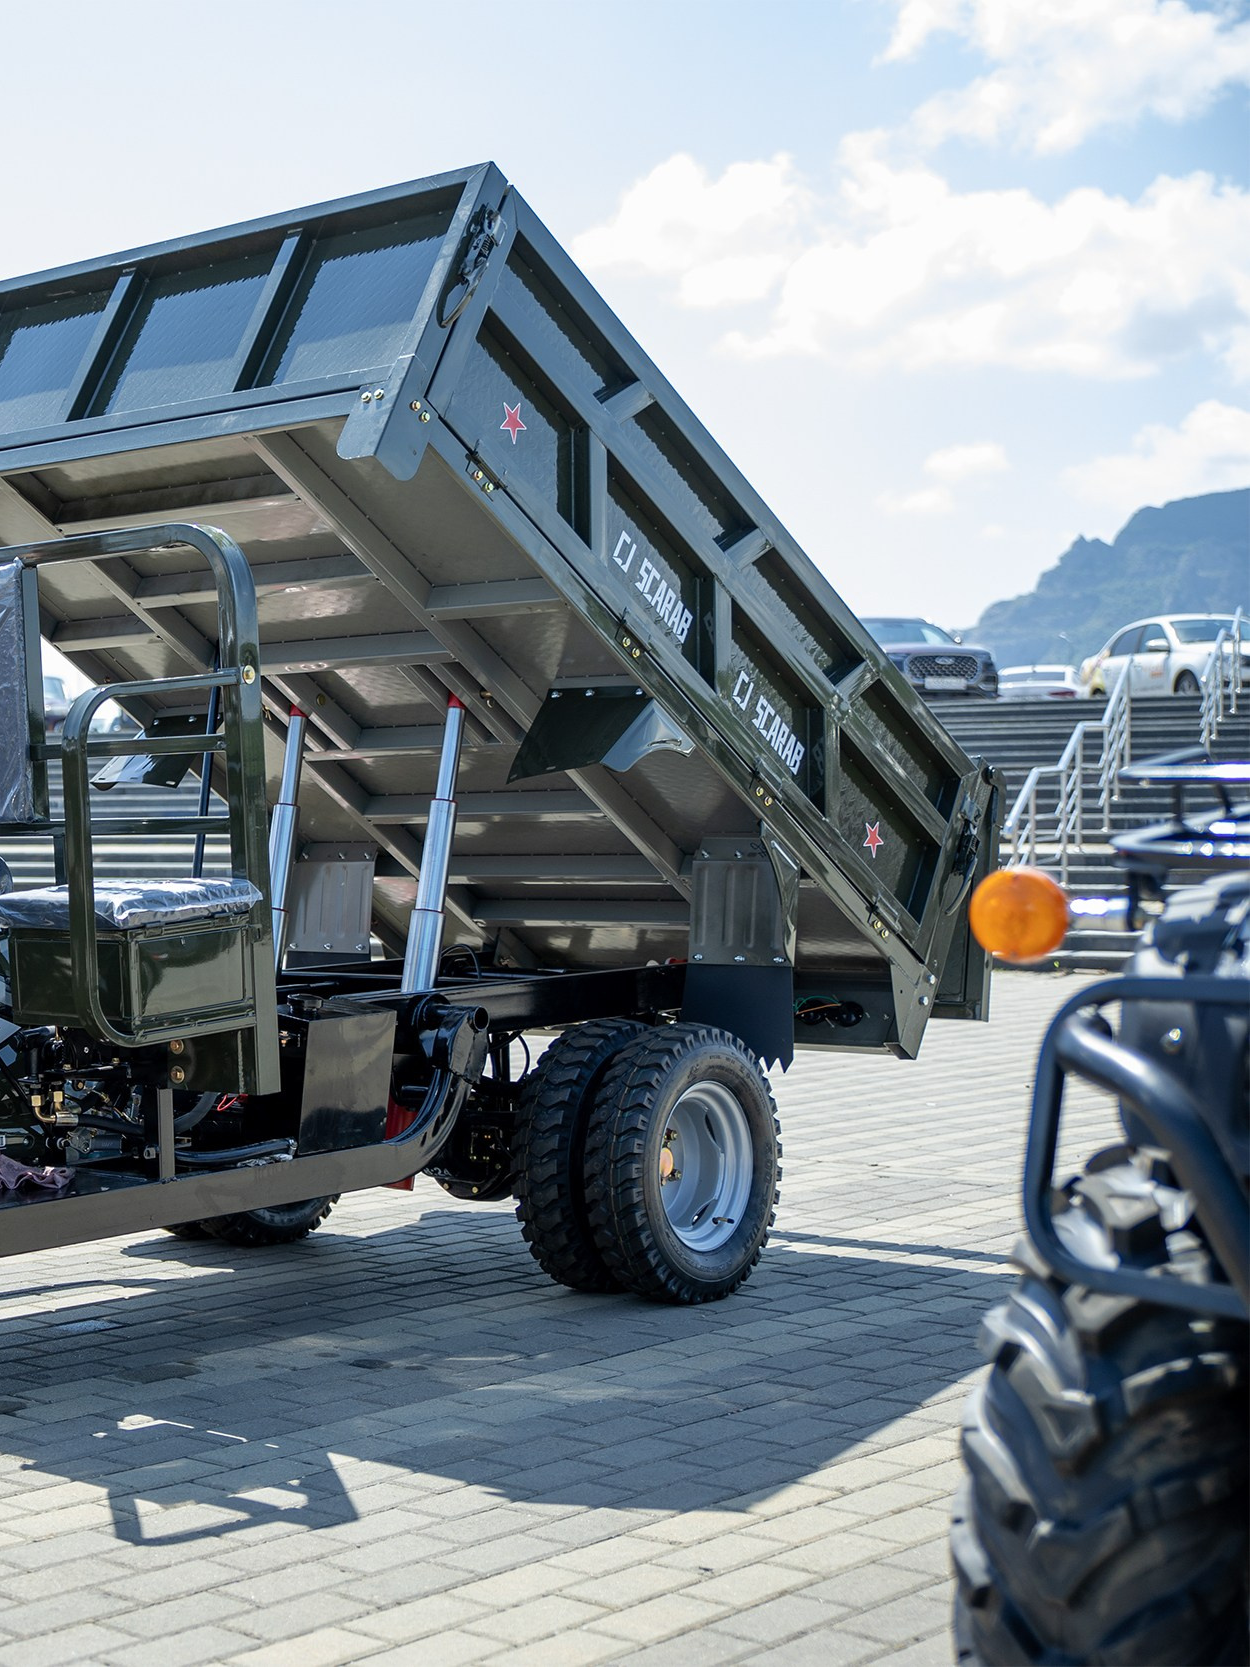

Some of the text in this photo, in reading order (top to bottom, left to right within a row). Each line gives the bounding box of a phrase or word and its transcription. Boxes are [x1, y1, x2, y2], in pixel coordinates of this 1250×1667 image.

[612, 530, 693, 644] CJ SCARAB
[732, 670, 805, 776] CJ SCARAB
